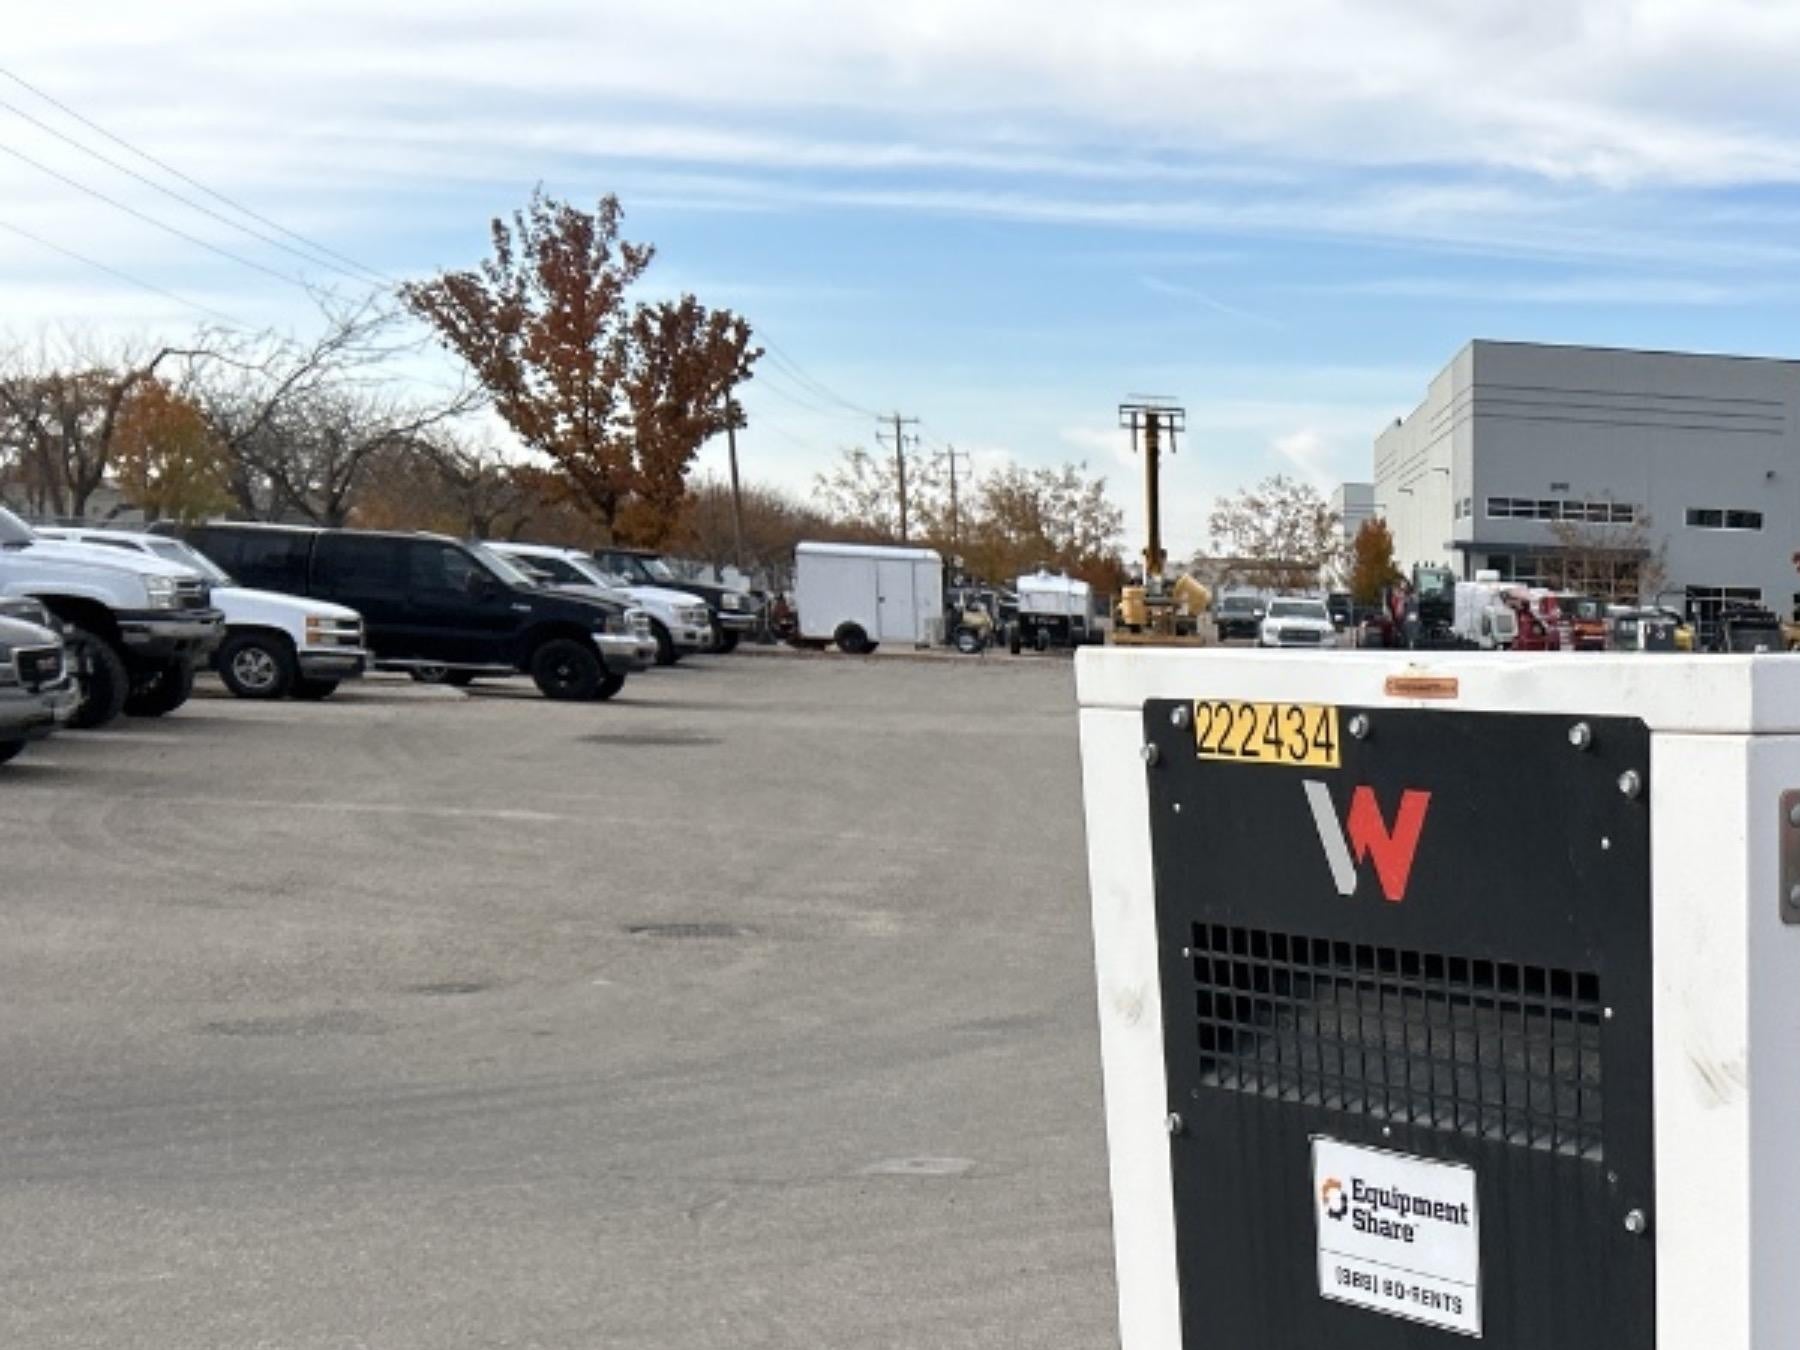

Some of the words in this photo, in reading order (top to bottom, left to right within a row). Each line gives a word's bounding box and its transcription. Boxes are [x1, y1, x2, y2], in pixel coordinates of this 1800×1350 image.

[1196, 701, 1335, 763] 222434
[1351, 1177, 1469, 1225] Equipment
[1352, 1207, 1414, 1243] Share
